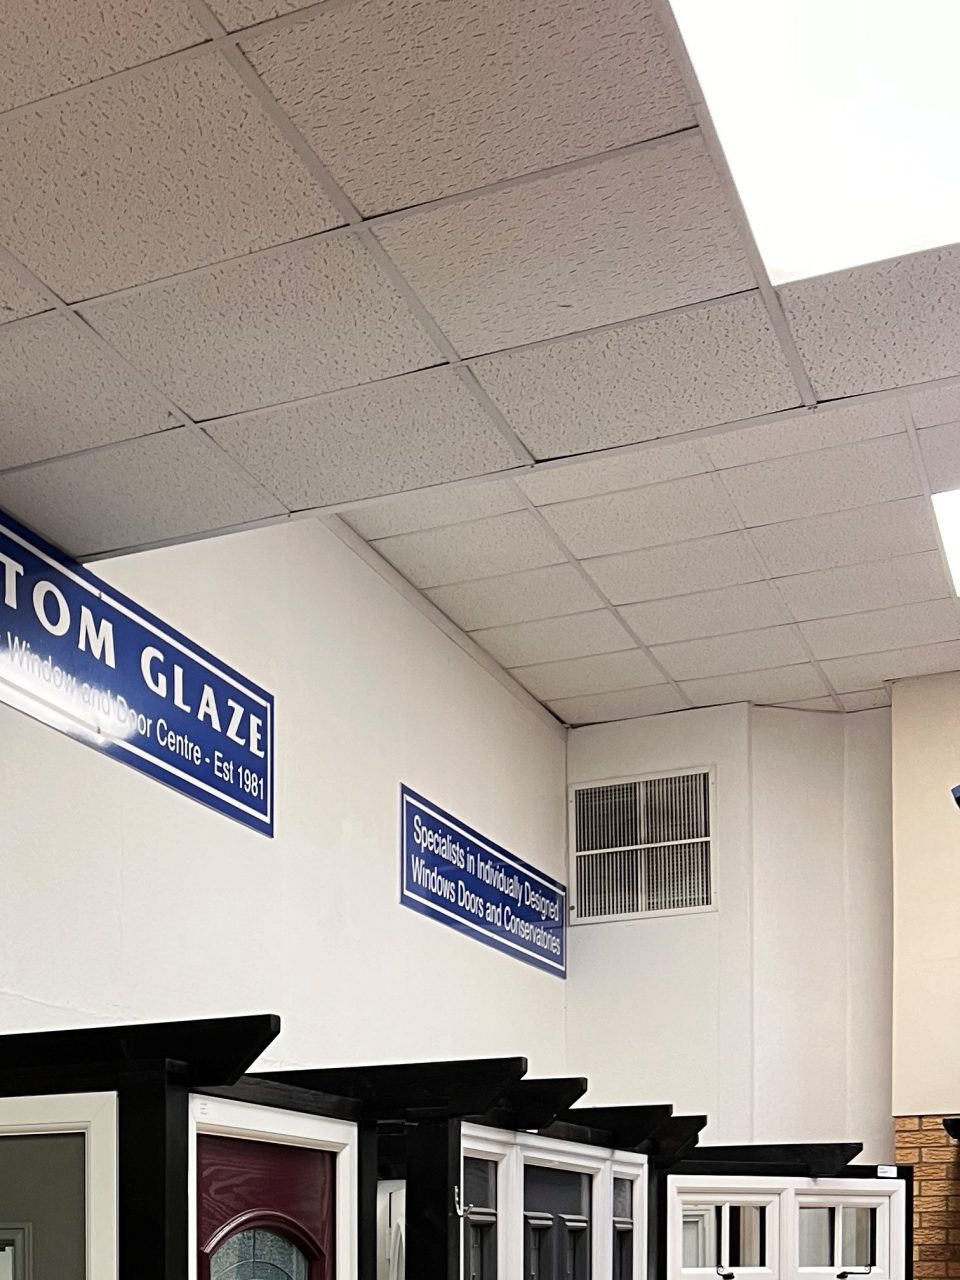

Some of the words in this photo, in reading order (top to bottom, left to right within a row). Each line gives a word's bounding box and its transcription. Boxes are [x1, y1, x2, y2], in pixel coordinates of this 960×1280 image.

[7, 631, 76, 696] Window
[82, 683, 111, 715] and
[116, 694, 152, 738] Door
[156, 718, 202, 766] Centre
[214, 750, 234, 784] Est
[237, 765, 264, 800] 1981
[141, 646, 265, 759] GLAZE
[411, 854, 456, 903] Windows
[457, 880, 484, 918] Doors
[485, 903, 502, 927] and
[504, 906, 561, 956] Conservatories
[413, 814, 464, 869] Specialists
[466, 847, 475, 876] in
[477, 853, 523, 907] Individually
[524, 881, 559, 922] Designed
